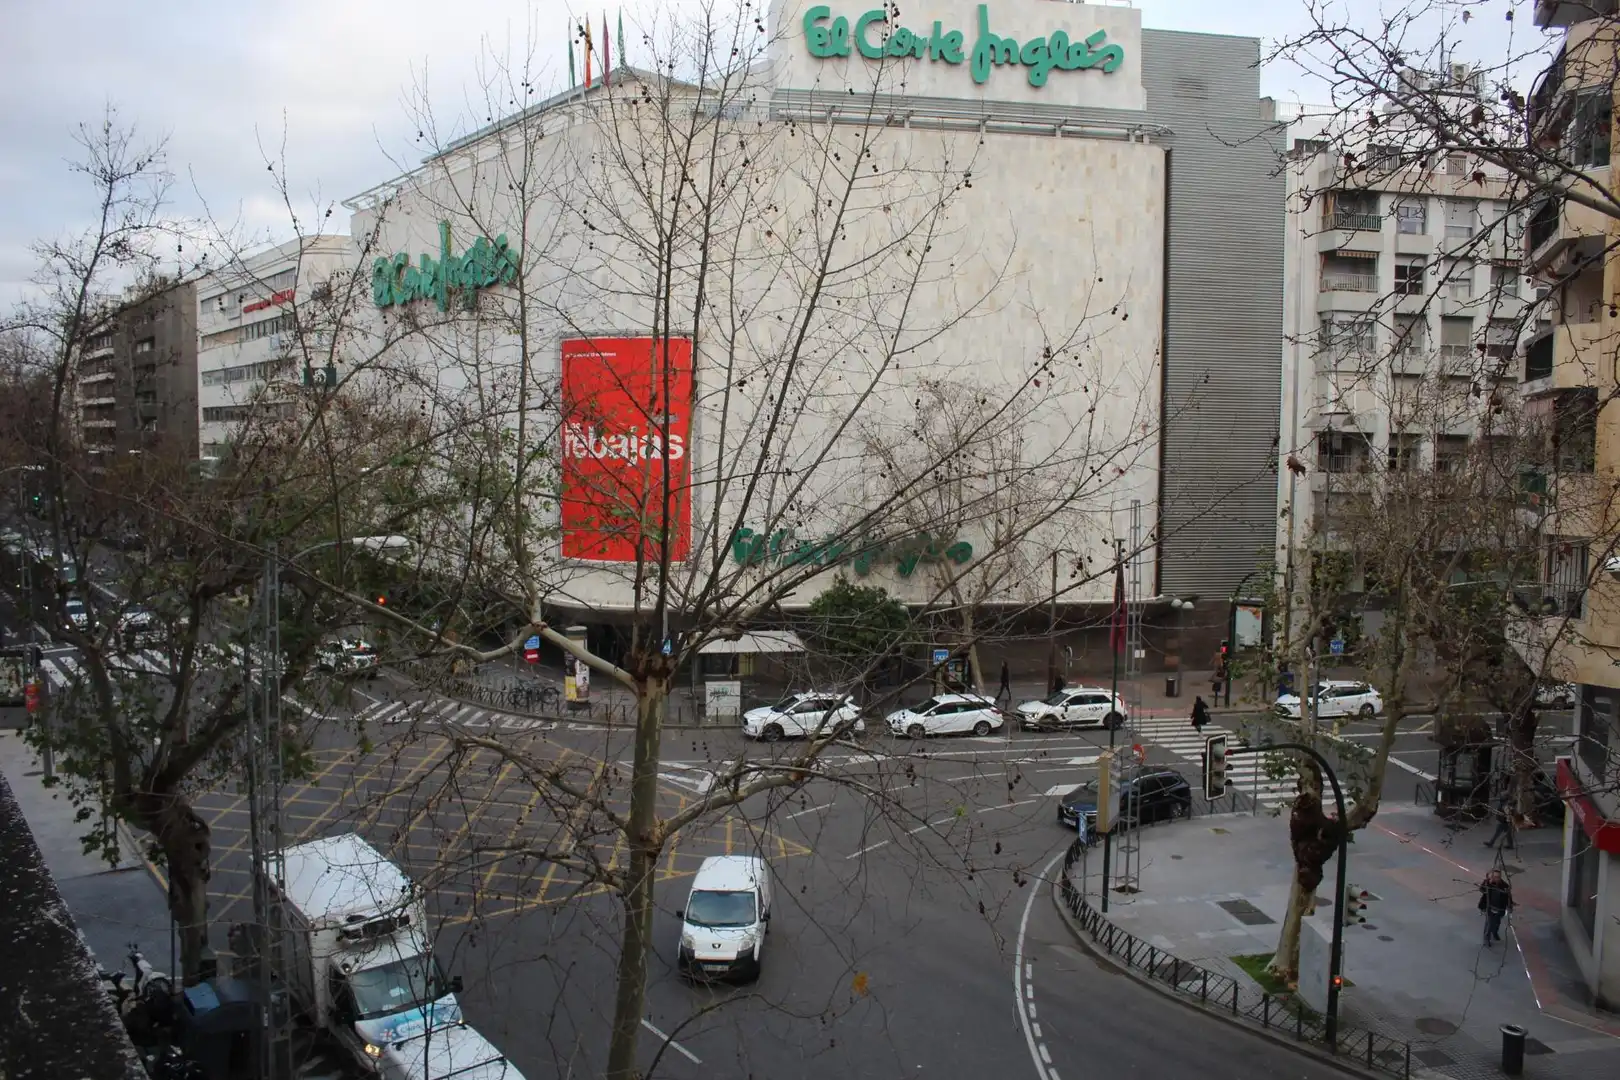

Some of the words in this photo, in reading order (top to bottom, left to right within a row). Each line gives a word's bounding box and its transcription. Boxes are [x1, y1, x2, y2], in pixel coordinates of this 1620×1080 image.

[803, 5, 849, 59] El
[855, 10, 965, 64] Corte
[971, 4, 1124, 88] Inglés
[565, 426, 684, 466] rebajas
